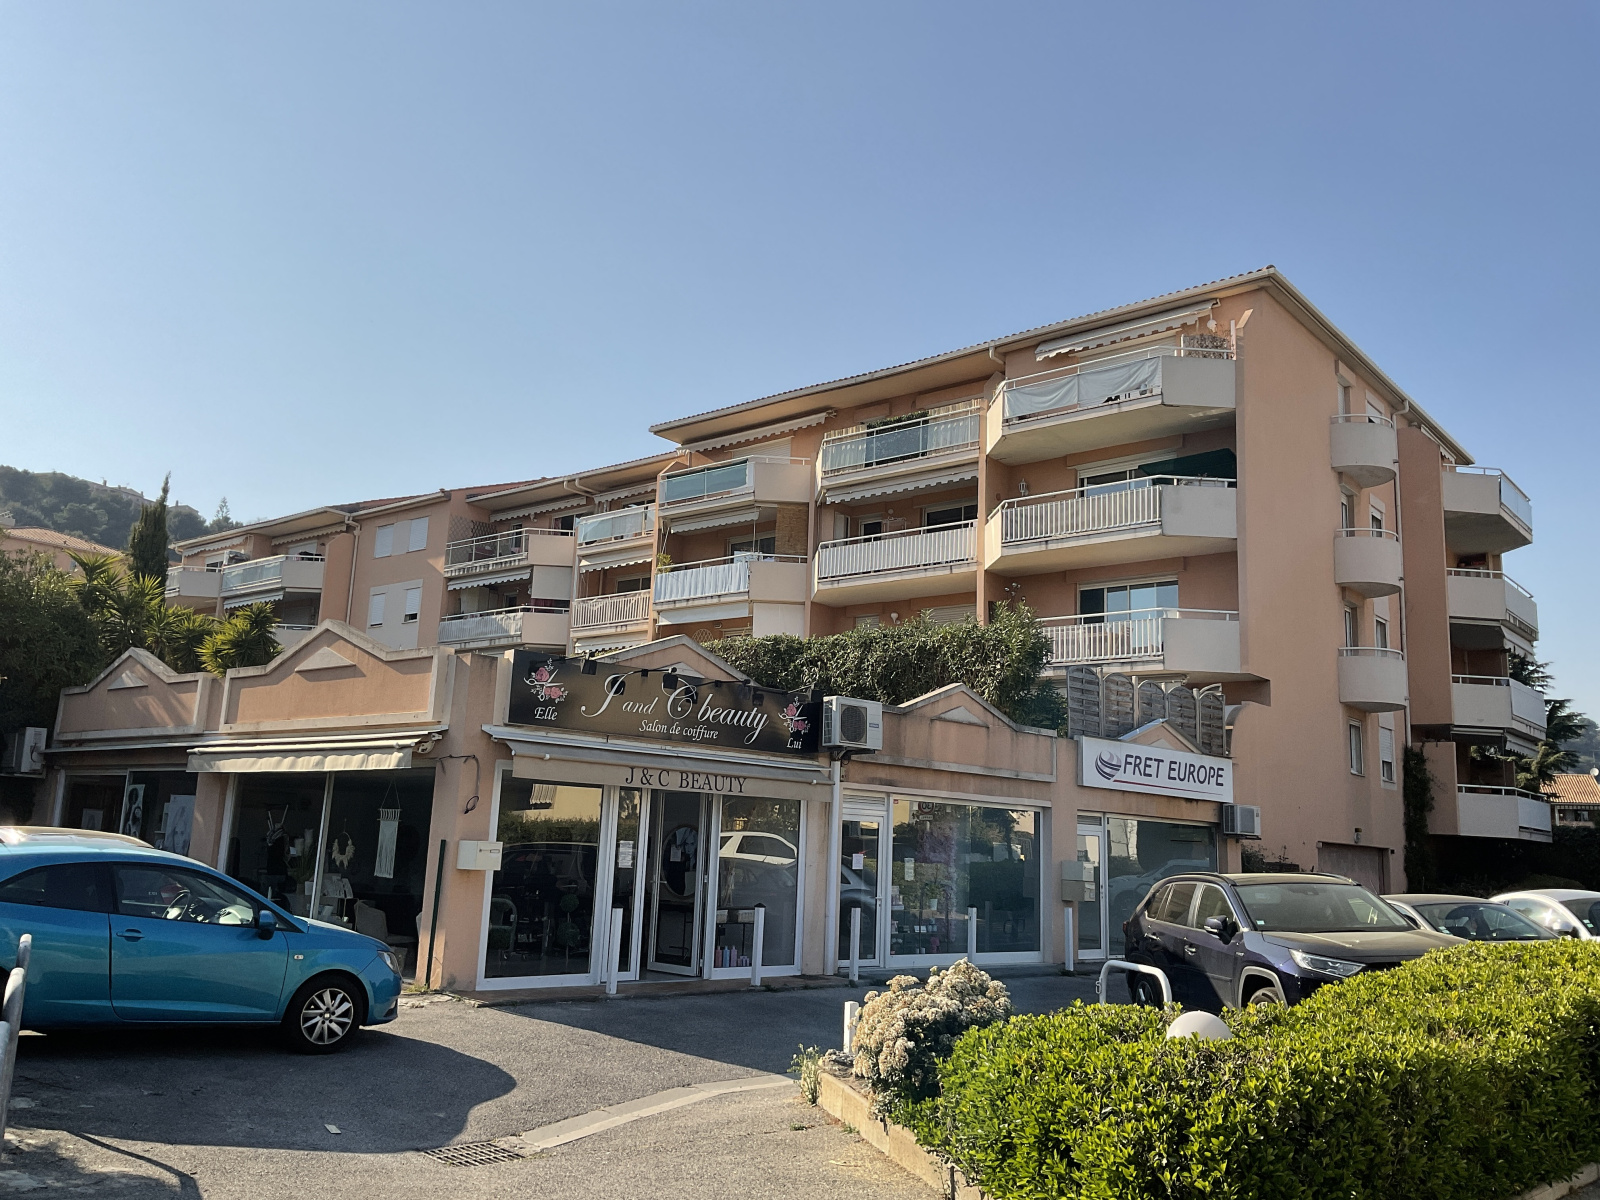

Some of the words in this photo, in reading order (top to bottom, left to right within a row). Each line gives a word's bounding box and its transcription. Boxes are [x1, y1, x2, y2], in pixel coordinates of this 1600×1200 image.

[534, 706, 558, 721] Elle
[580, 671, 634, 718] J
[622, 696, 659, 715] and
[661, 677, 697, 720] C
[697, 693, 770, 745] beauty
[638, 719, 668, 734] Salon
[669, 721, 681, 735] de
[682, 724, 719, 741] coiffure
[786, 737, 803, 749] Lui
[625, 767, 636, 785] J
[640, 767, 654, 786] &
[658, 769, 670, 787] C
[678, 771, 748, 793] BEAUTY
[1123, 753, 1165, 779] FRET
[1167, 760, 1225, 787] EUROPE
